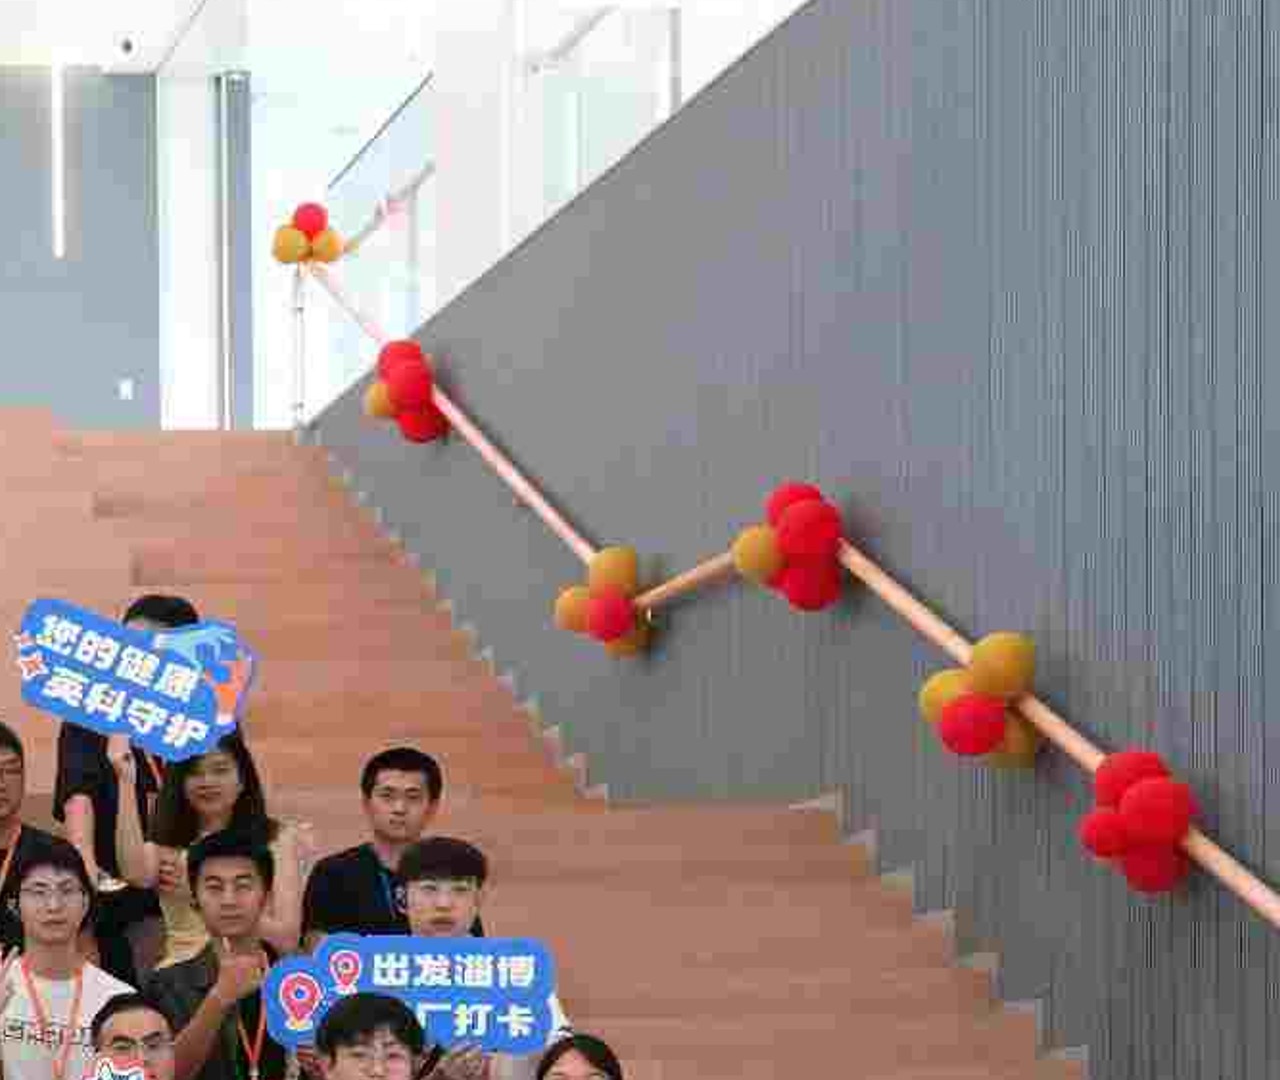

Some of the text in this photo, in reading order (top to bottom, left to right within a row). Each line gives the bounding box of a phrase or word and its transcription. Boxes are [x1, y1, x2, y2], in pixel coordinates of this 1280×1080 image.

[37, 615, 201, 701] 您的健康
[41, 665, 209, 748] 英科守护
[373, 952, 536, 987] 出发淄博
[414, 1001, 535, 1036] 厂打卡
